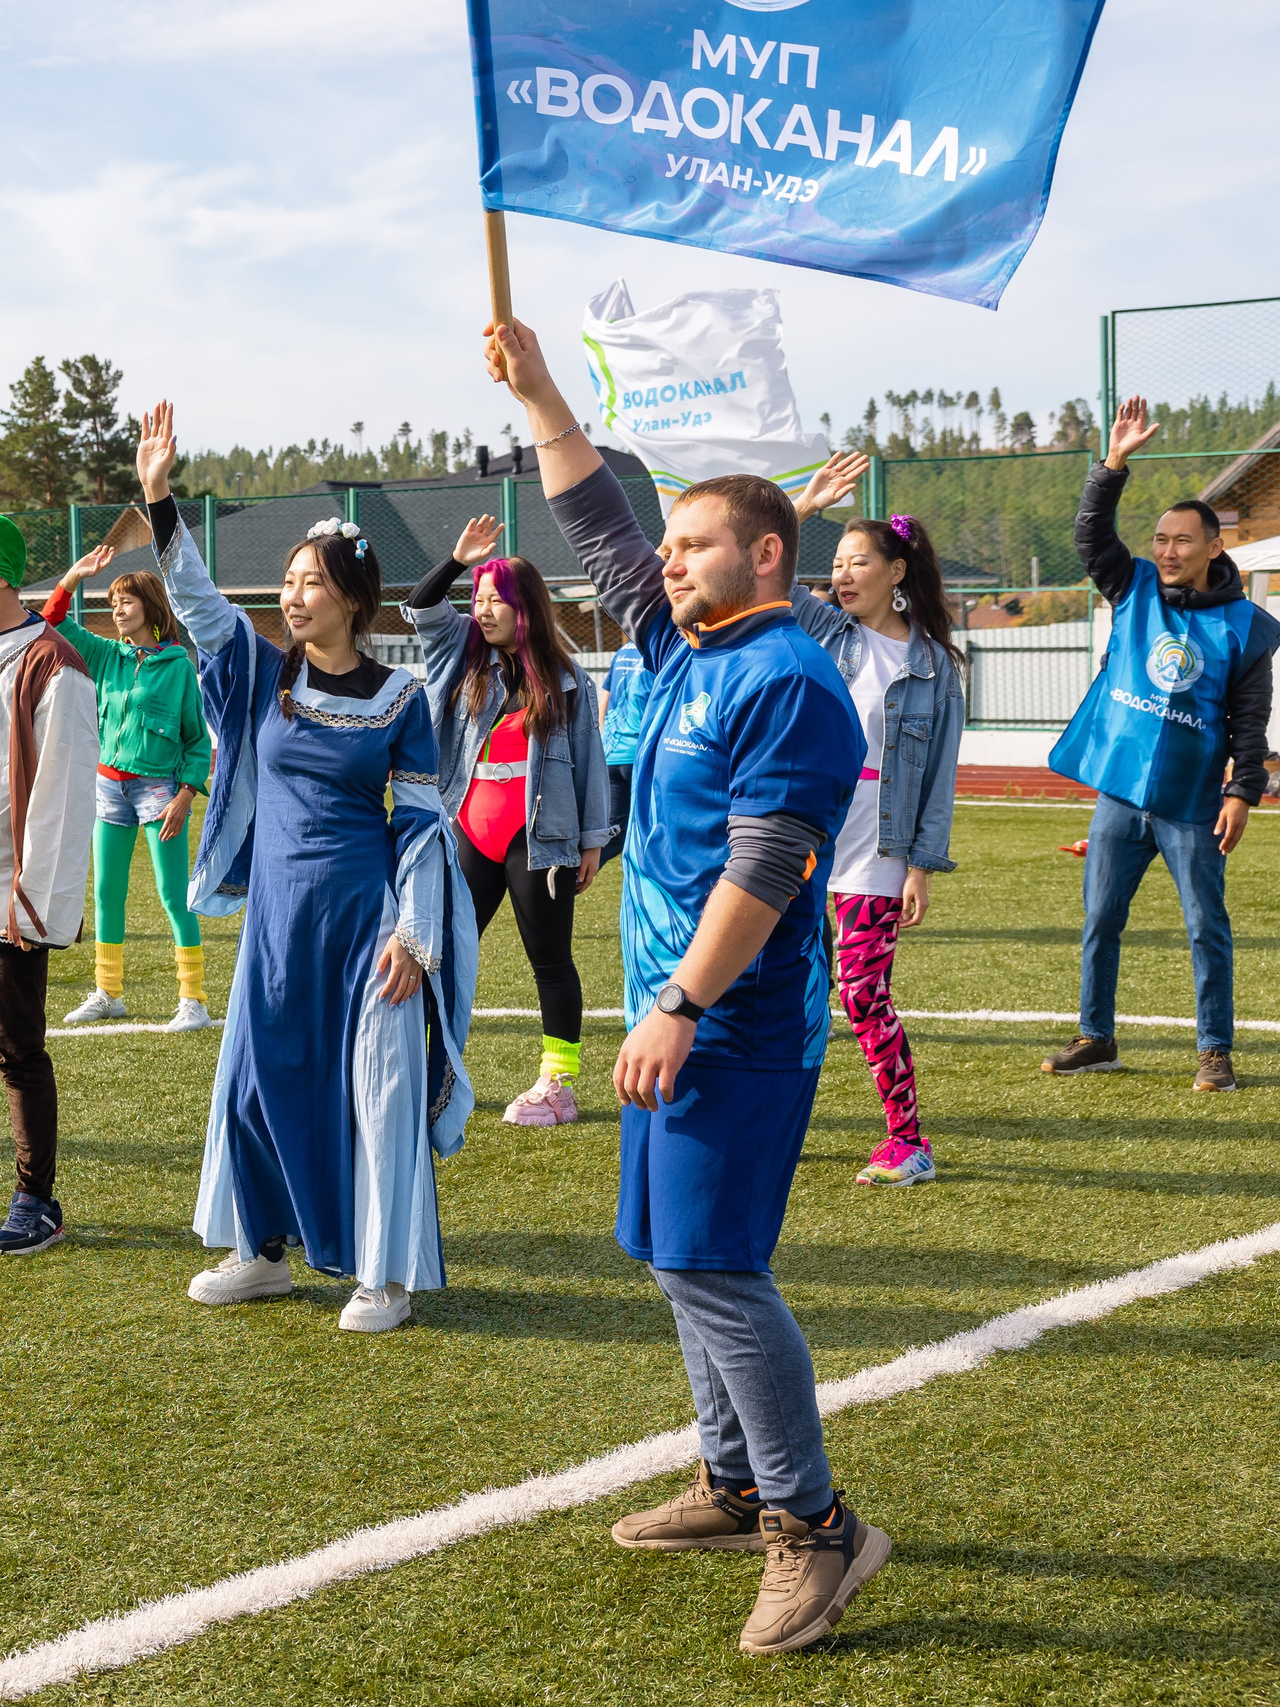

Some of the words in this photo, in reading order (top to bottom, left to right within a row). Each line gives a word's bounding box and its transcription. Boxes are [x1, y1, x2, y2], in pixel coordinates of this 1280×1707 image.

[691, 28, 820, 89] МУП
[506, 66, 988, 183] «ВОДОКАНАЛ»
[665, 153, 820, 204] УЛАН-УДЭ
[623, 371, 747, 410] ВОДОКАНАЛ
[632, 410, 713, 433] Улан-Удэ
[1150, 693, 1170, 706] МУП
